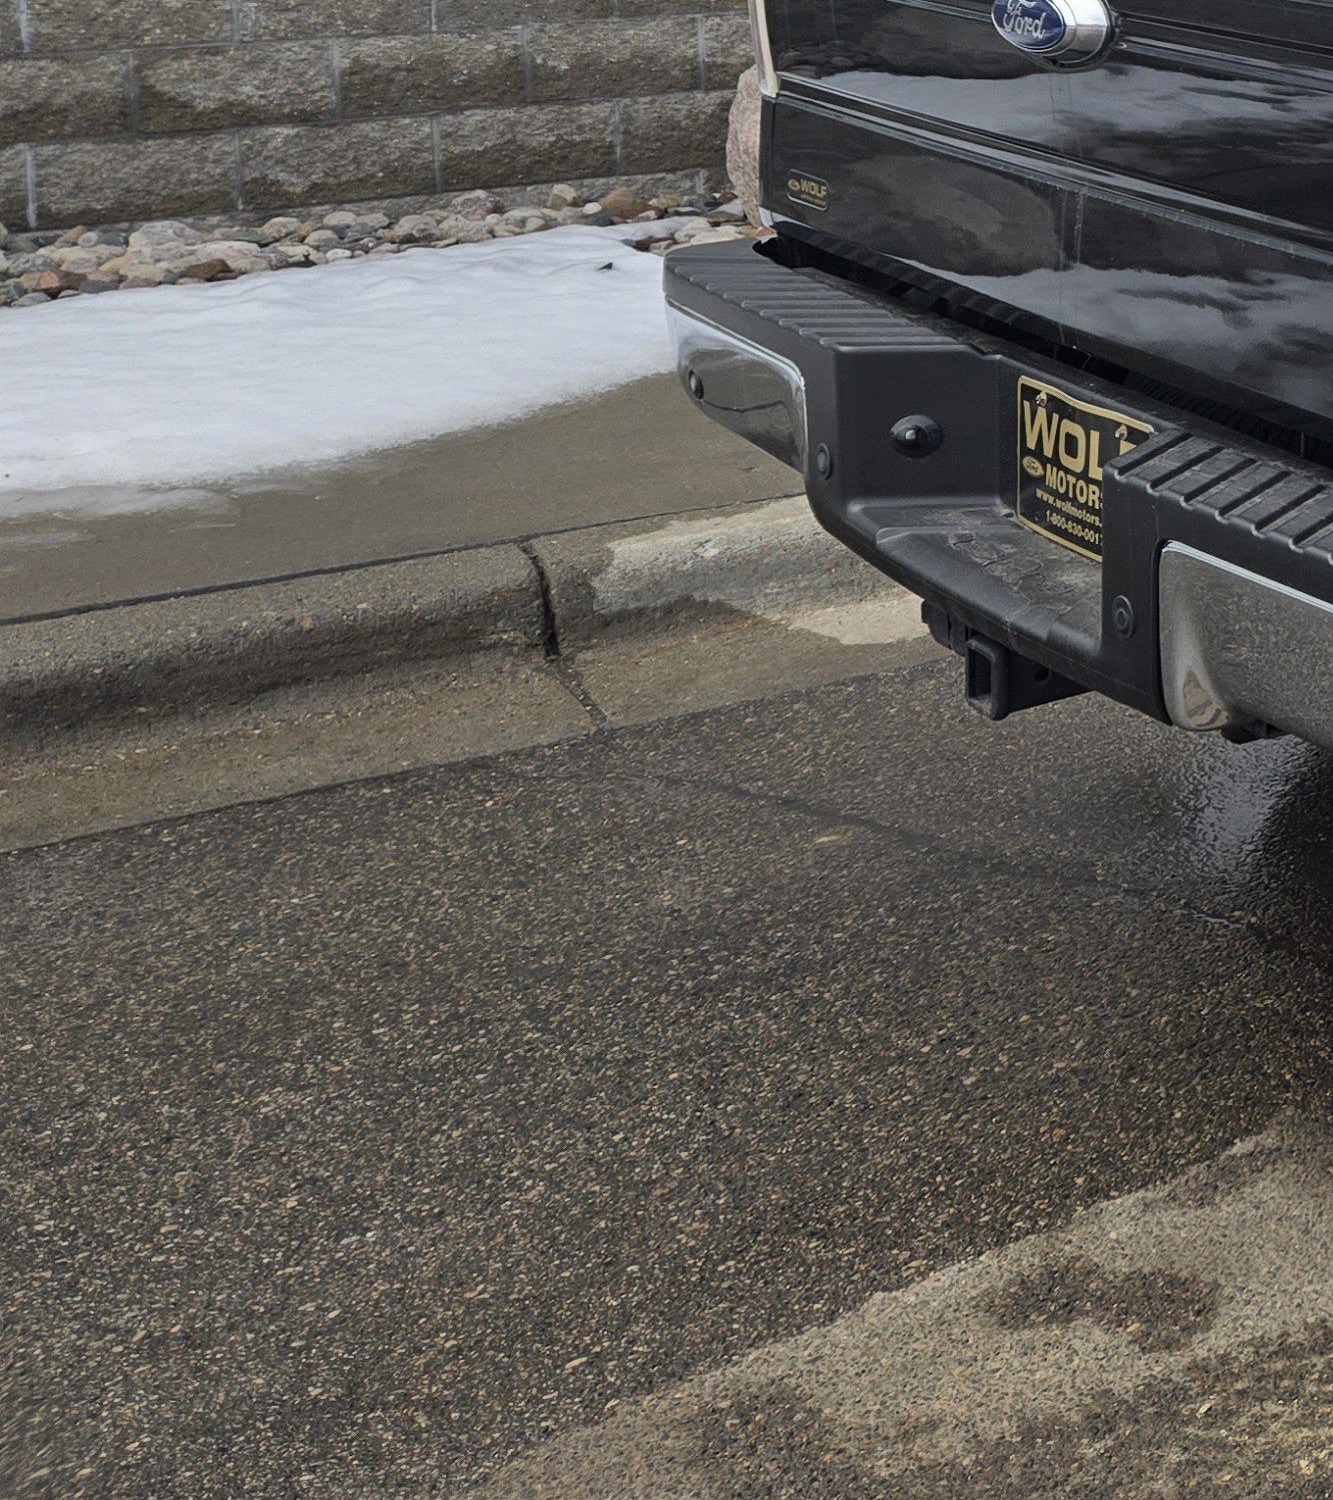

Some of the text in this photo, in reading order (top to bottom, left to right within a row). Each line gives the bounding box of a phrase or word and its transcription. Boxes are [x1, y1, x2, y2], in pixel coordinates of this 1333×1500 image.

[800, 178, 828, 198] WOLF
[1045, 463, 1103, 510] MOTOR
[1045, 509, 1103, 546] 1-800-830-001
